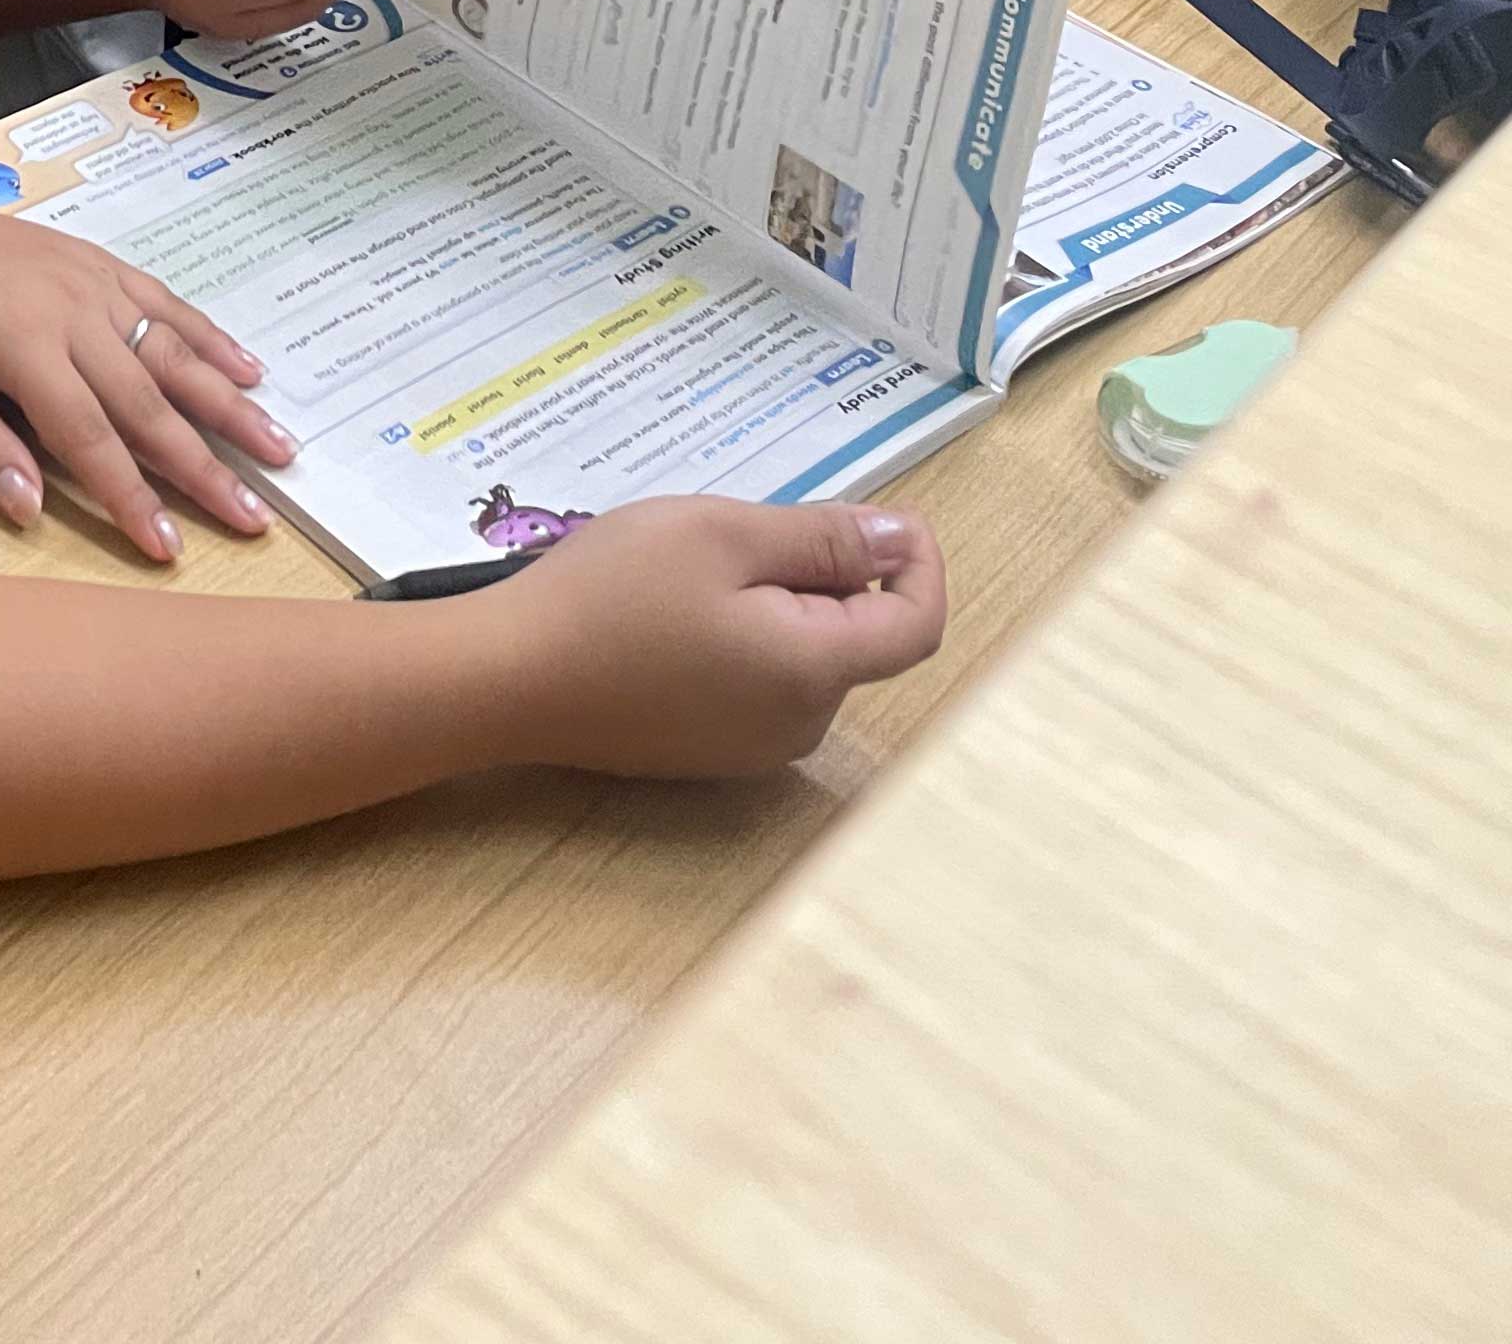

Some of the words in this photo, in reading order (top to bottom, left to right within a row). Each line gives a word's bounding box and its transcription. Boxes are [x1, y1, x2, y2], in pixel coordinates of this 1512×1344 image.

[932, 0, 945, 22] the
[302, 34, 329, 52] How
[923, 23, 940, 55] past
[266, 52, 285, 67] we
[284, 46, 302, 60] do
[232, 59, 268, 81] know
[903, 114, 920, 147] from
[894, 148, 911, 179] your
[1148, 124, 1238, 180] Comprehension
[1080, 199, 1185, 254] Understand
[657, 218, 720, 263] Writing
[614, 251, 664, 289] Study
[654, 282, 688, 309] cyclist
[711, 275, 764, 311] sentences.
[748, 286, 782, 313] Listen
[597, 306, 649, 342] cartoonist
[685, 303, 716, 327] Write
[704, 316, 731, 339] read
[728, 304, 752, 325] and
[650, 329, 670, 348] -ist
[667, 318, 689, 338] the
[686, 330, 708, 349] the
[792, 322, 817, 343] This
[552, 339, 590, 367] dentist
[618, 338, 654, 366] words
[653, 340, 690, 369] words.
[752, 352, 769, 367] an
[766, 334, 798, 360] helps
[511, 364, 545, 390] florist
[598, 355, 621, 375] you
[624, 360, 657, 386] Circle
[825, 350, 869, 384] Learn
[883, 356, 927, 390] Word
[561, 383, 577, 399] in
[574, 368, 602, 391] hear
[605, 377, 627, 397] the
[466, 388, 504, 416] tourist
[537, 388, 564, 410] your
[563, 388, 609, 422] suffixes.
[836, 379, 886, 416] Study
[482, 404, 540, 445] notebook.
[536, 413, 567, 437] Then
[658, 401, 690, 426] learn
[418, 413, 457, 442] pianist
[631, 418, 660, 441] more
[492, 446, 509, 463] to
[506, 428, 540, 455] listen
[600, 435, 634, 461] about
[472, 454, 496, 475] the
[578, 454, 603, 475] how
